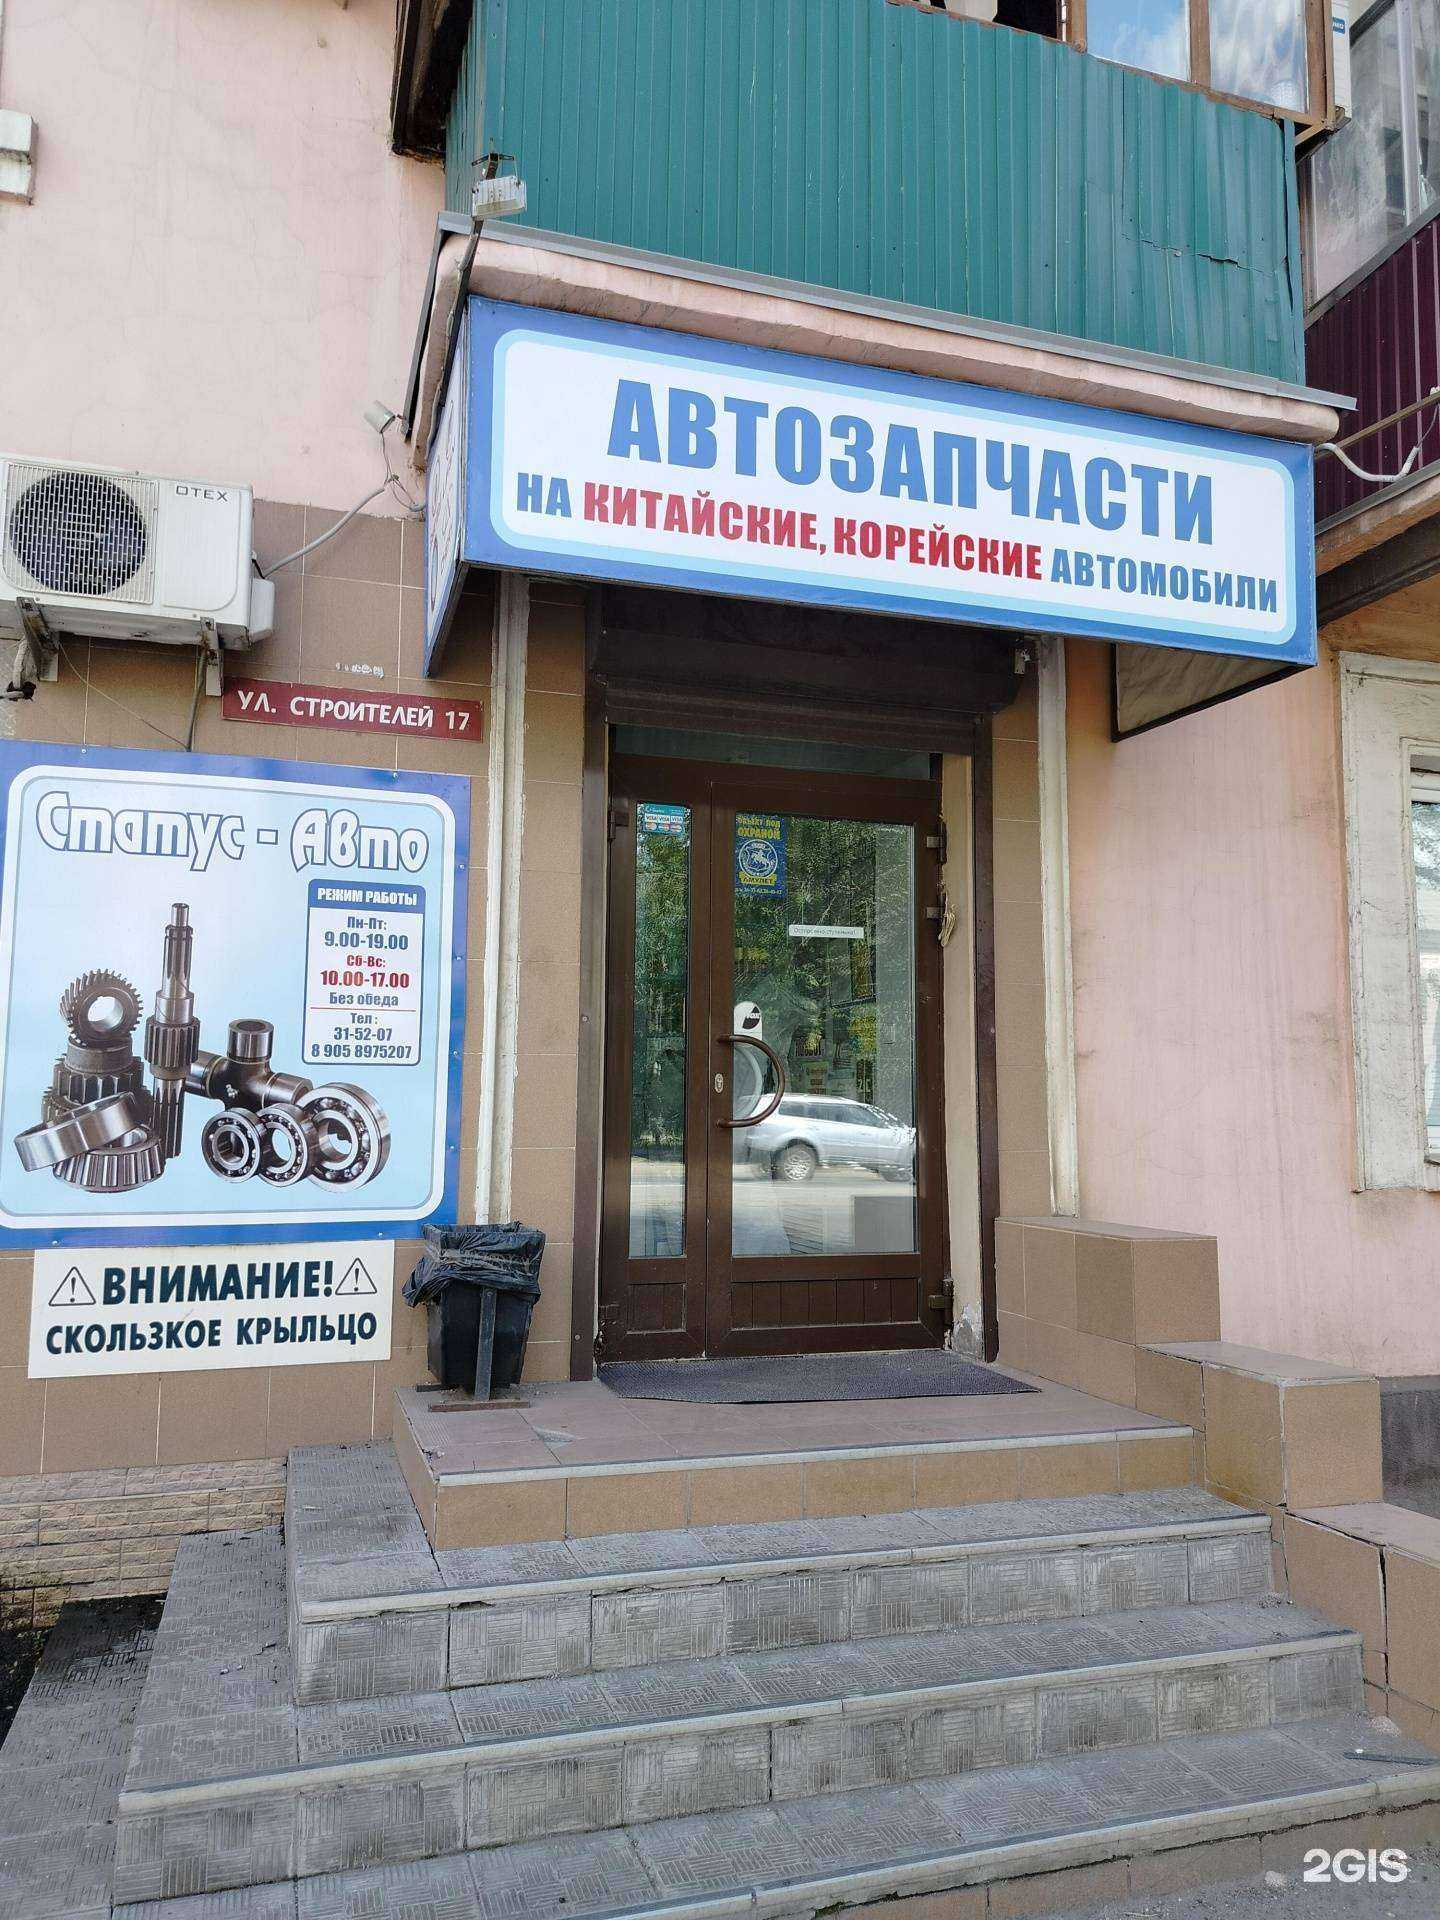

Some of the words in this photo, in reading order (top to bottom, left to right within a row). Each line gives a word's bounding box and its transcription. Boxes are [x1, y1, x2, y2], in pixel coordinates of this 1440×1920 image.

[607, 379, 1213, 545] АВТОЗАПЧАСТИ
[176, 485, 228, 501] OTEX
[517, 472, 572, 518] НА
[584, 482, 826, 555] КИТАЙСКИЕ,
[834, 517, 1042, 580] КОРЕЙСКИЕ
[1051, 548, 1277, 612] АВТОМОБИЛИ
[237, 690, 277, 713] УЛ.
[290, 696, 434, 728] СТРОИТЕЛЕЙ
[445, 711, 470, 731] 17
[290, 808, 429, 873] Авто
[317, 887, 363, 903] РЕЖИМ
[365, 889, 418, 906] РАБОТЫ
[347, 916, 387, 931] Пн-Пт:
[324, 931, 409, 951] 9.00-19.00
[346, 954, 386, 968] Сб-Вс:
[320, 970, 410, 989] 10.00-17.00
[329, 992, 354, 1005] Без
[357, 993, 399, 1007] обеда
[333, 1026, 393, 1042] 31-52-07
[311, 1044, 320, 1057] 8
[324, 1044, 350, 1058] 905
[354, 1044, 412, 1059] 8975207
[102, 1260, 334, 1306] ВНИМАНИЕ!
[46, 1319, 221, 1355] СКОЛЬЗКОЕ
[236, 1311, 378, 1346] КРЫЛЬЦО
